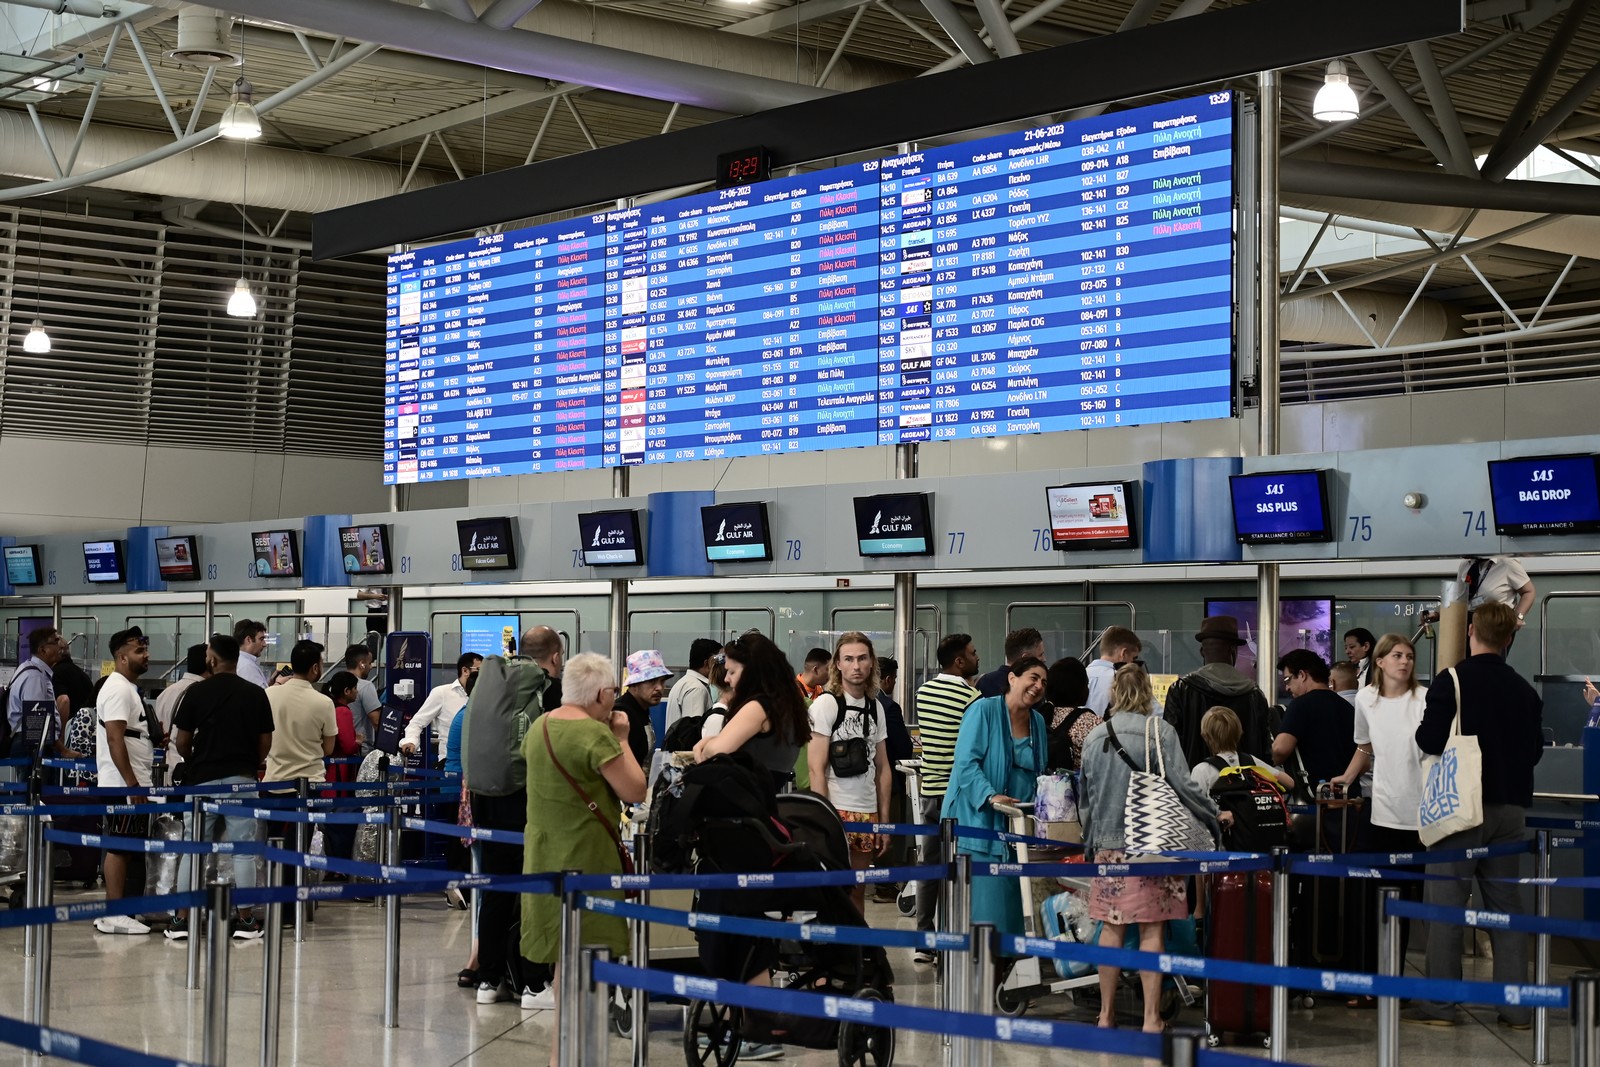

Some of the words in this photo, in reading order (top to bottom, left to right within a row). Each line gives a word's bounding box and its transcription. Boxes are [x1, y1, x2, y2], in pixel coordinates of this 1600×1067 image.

[1208, 92, 1229, 104] 13:29
[1153, 115, 1196, 128] Παρατηρήσεις
[1024, 124, 1064, 140] 21-06-2023
[1153, 132, 1171, 142] Πύλη
[1173, 125, 1201, 139] Ανοιχτή
[1081, 143, 1108, 156] 038-042
[1116, 140, 1124, 150] A1
[1153, 145, 1190, 159] Επιβίβαση
[881, 153, 924, 168] Αναχωρήσεις
[972, 154, 986, 162] Code
[1008, 157, 1034, 169] Λονδίνο
[1035, 154, 1049, 164] LHR
[1116, 154, 1129, 165] A18
[730, 156, 757, 178] 13:29
[862, 160, 878, 171] 13:29
[972, 167, 981, 176] AA
[982, 164, 996, 174] 6854
[1081, 158, 1108, 171] 009-014
[937, 174, 946, 182] BA
[946, 171, 958, 180] 639
[1008, 172, 1030, 184] Πεκίνο
[1081, 174, 1106, 185] 102-141
[1116, 170, 1128, 180] B27
[1153, 178, 1171, 188] Πύλη
[1172, 172, 1200, 185] Ανοιχτή
[720, 185, 750, 199] 21-06-2023
[881, 183, 895, 192] 14:10
[937, 188, 945, 196] CA
[946, 185, 957, 195] 864
[1009, 188, 1028, 198] Ρόδος
[1116, 185, 1129, 195] B29
[1081, 204, 1105, 215] 136-141
[1116, 200, 1128, 210] C32
[592, 214, 605, 224] 13:29
[1008, 216, 1035, 228] Τορόντο
[1037, 213, 1049, 222] YYZ
[1153, 224, 1171, 234] Πύλη
[1173, 219, 1201, 231] Κλειστή
[1116, 245, 1129, 255] B30
[1008, 258, 1042, 271] Κοπεγχάγη
[1081, 264, 1105, 275] 127-132
[1115, 261, 1124, 270] A3
[1080, 278, 1106, 290] 073-075
[936, 300, 944, 309] SK
[945, 299, 956, 308] 778
[972, 296, 977, 304] FI
[978, 294, 993, 303] 7436
[1008, 318, 1029, 330] Παρίσι
[1030, 316, 1044, 326] CDG
[1080, 339, 1107, 350] 077-080
[1007, 346, 1038, 359] Μπαχρέιν
[901, 361, 919, 370] GULF
[817, 370, 828, 379] Νέα
[829, 368, 844, 378] Πύλη
[901, 389, 925, 397] AEGEAN
[1080, 384, 1107, 395] 050-052
[817, 395, 844, 405] Τελευταία
[846, 392, 874, 404] Αναγγελία
[1007, 391, 1033, 401] Λονδίνο
[1034, 390, 1046, 399] LTN
[945, 398, 959, 407] 7806
[1007, 420, 1039, 431] Σαντορίνη
[1080, 415, 1104, 425] 102-141
[1531, 470, 1554, 482] SAS
[1265, 484, 1284, 495] SAS
[1519, 490, 1540, 501] BAG
[1542, 489, 1571, 500] DROP
[1257, 503, 1274, 513] SAS
[1275, 502, 1298, 512] PLUS
[1349, 516, 1372, 541] 75
[1462, 510, 1487, 537] 74
[255, 538, 270, 546] BEST
[342, 533, 359, 542] BEST
[948, 532, 965, 554] 77
[1032, 529, 1050, 551] 76
[786, 540, 801, 560] 78
[572, 549, 584, 568] 79
[401, 556, 411, 573] 81
[208, 564, 217, 579] 83
[49, 570, 56, 585] 85
[1557, 838, 1575, 846] ATHENS
[1471, 848, 1489, 857] ATHENS
[748, 874, 774, 883] ATHENS
[865, 869, 890, 878] ATHENS
[622, 875, 650, 884] ATHENS
[309, 885, 343, 896] ATHENS
[697, 914, 720, 924] ATHENS
[1477, 912, 1510, 922] ATHENS
[810, 926, 836, 936] ATHENS
[936, 934, 964, 942] ATHENS
[1172, 956, 1204, 968] ATHENS
[1336, 973, 1372, 985] ATHENS
[1522, 986, 1562, 998] ATHENS
[837, 998, 874, 1013] ATHENS
